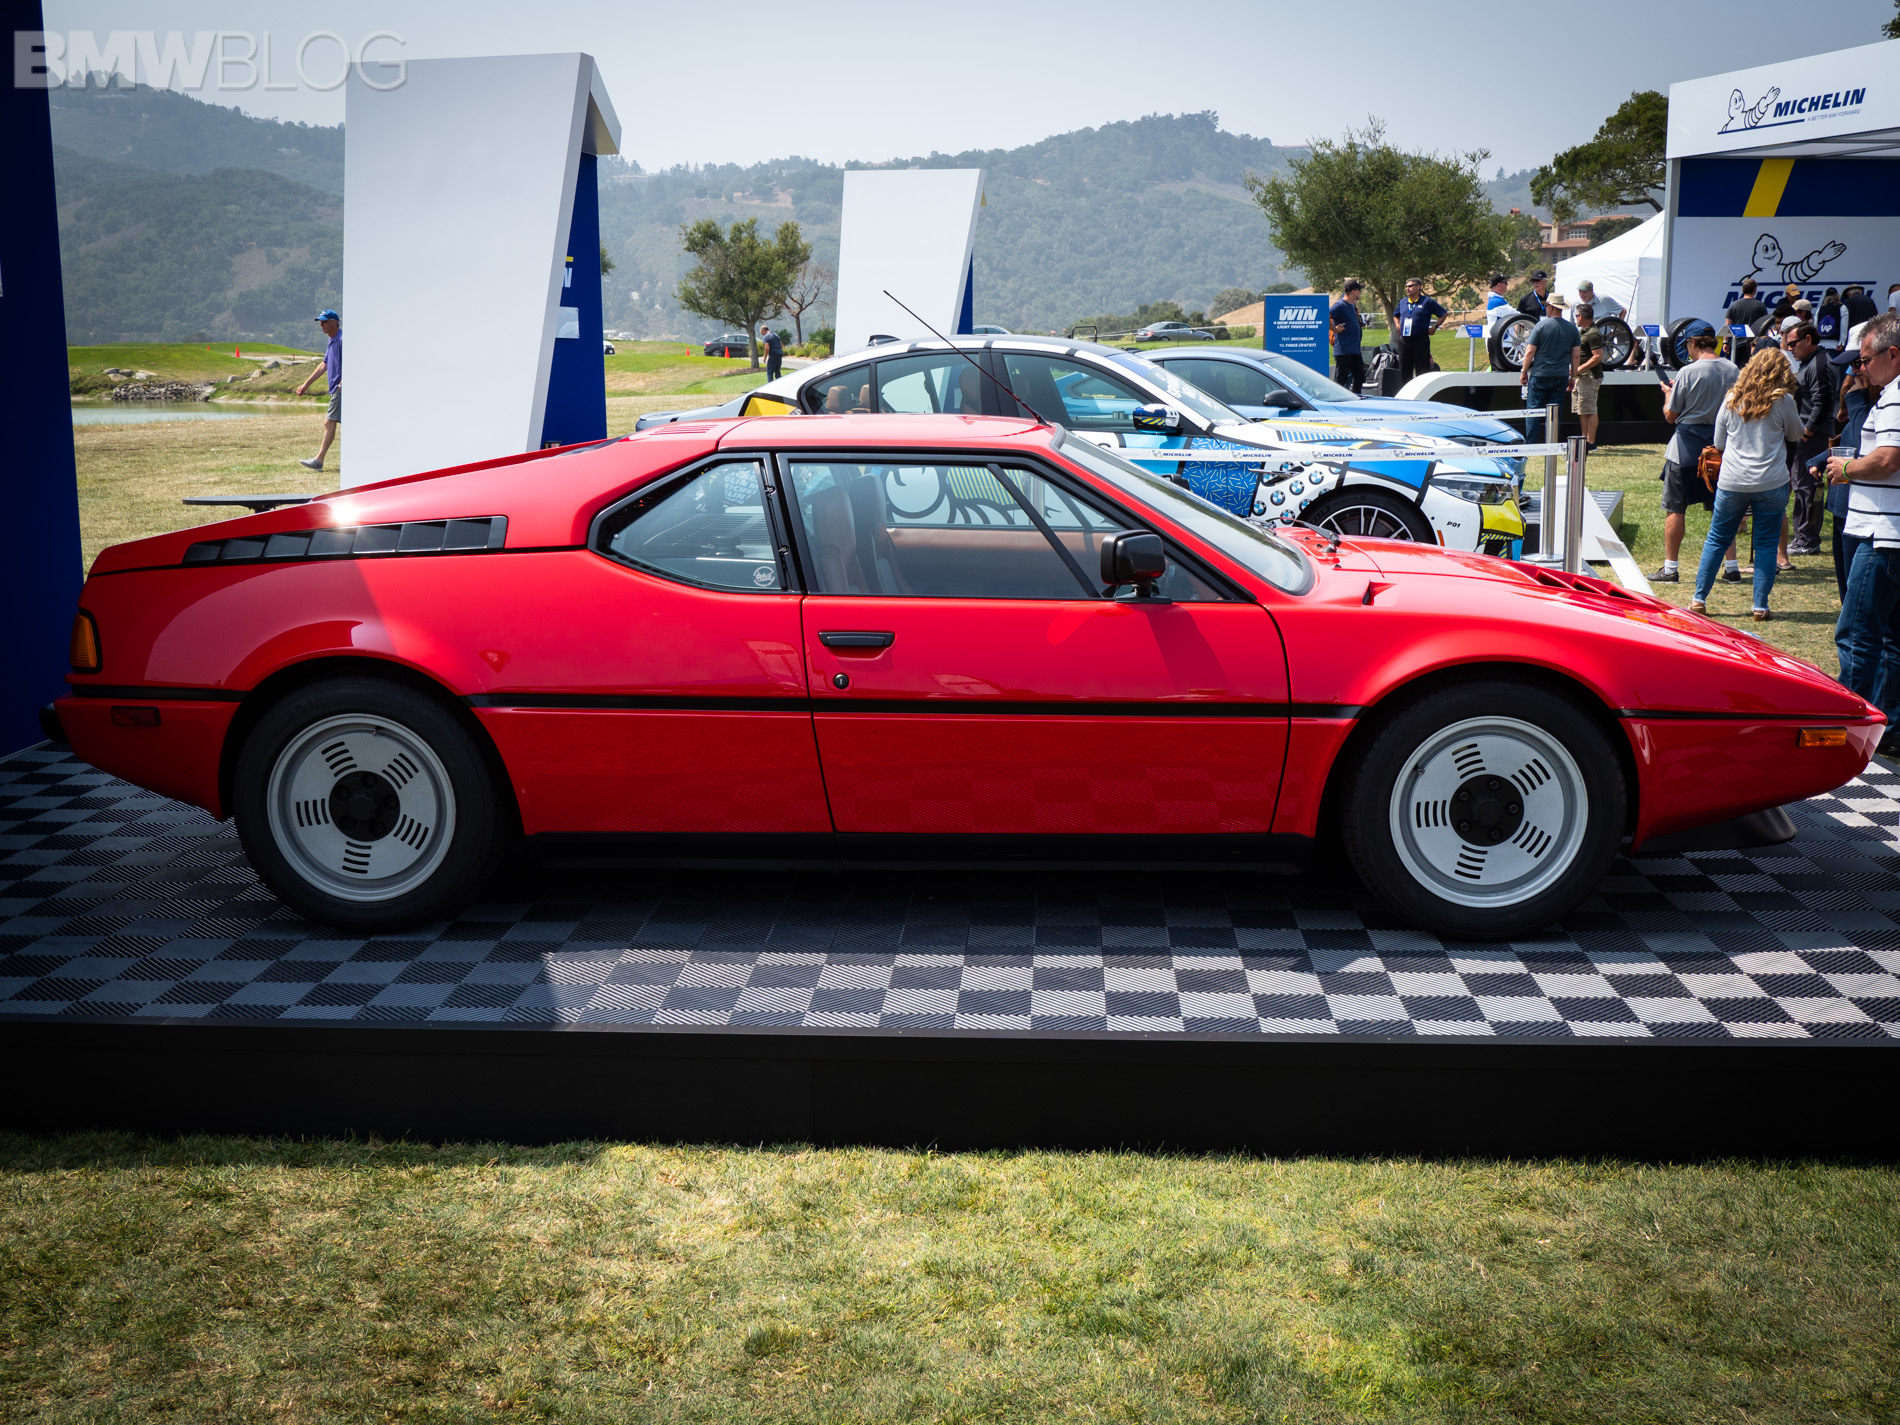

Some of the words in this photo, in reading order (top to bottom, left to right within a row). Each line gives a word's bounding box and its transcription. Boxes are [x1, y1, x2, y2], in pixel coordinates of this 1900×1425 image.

[1772, 86, 1867, 118] MICHELIN
[1811, 113, 1828, 121] BETTER
[1838, 108, 1861, 118] FORWARD
[1279, 308, 1318, 320] WIN
